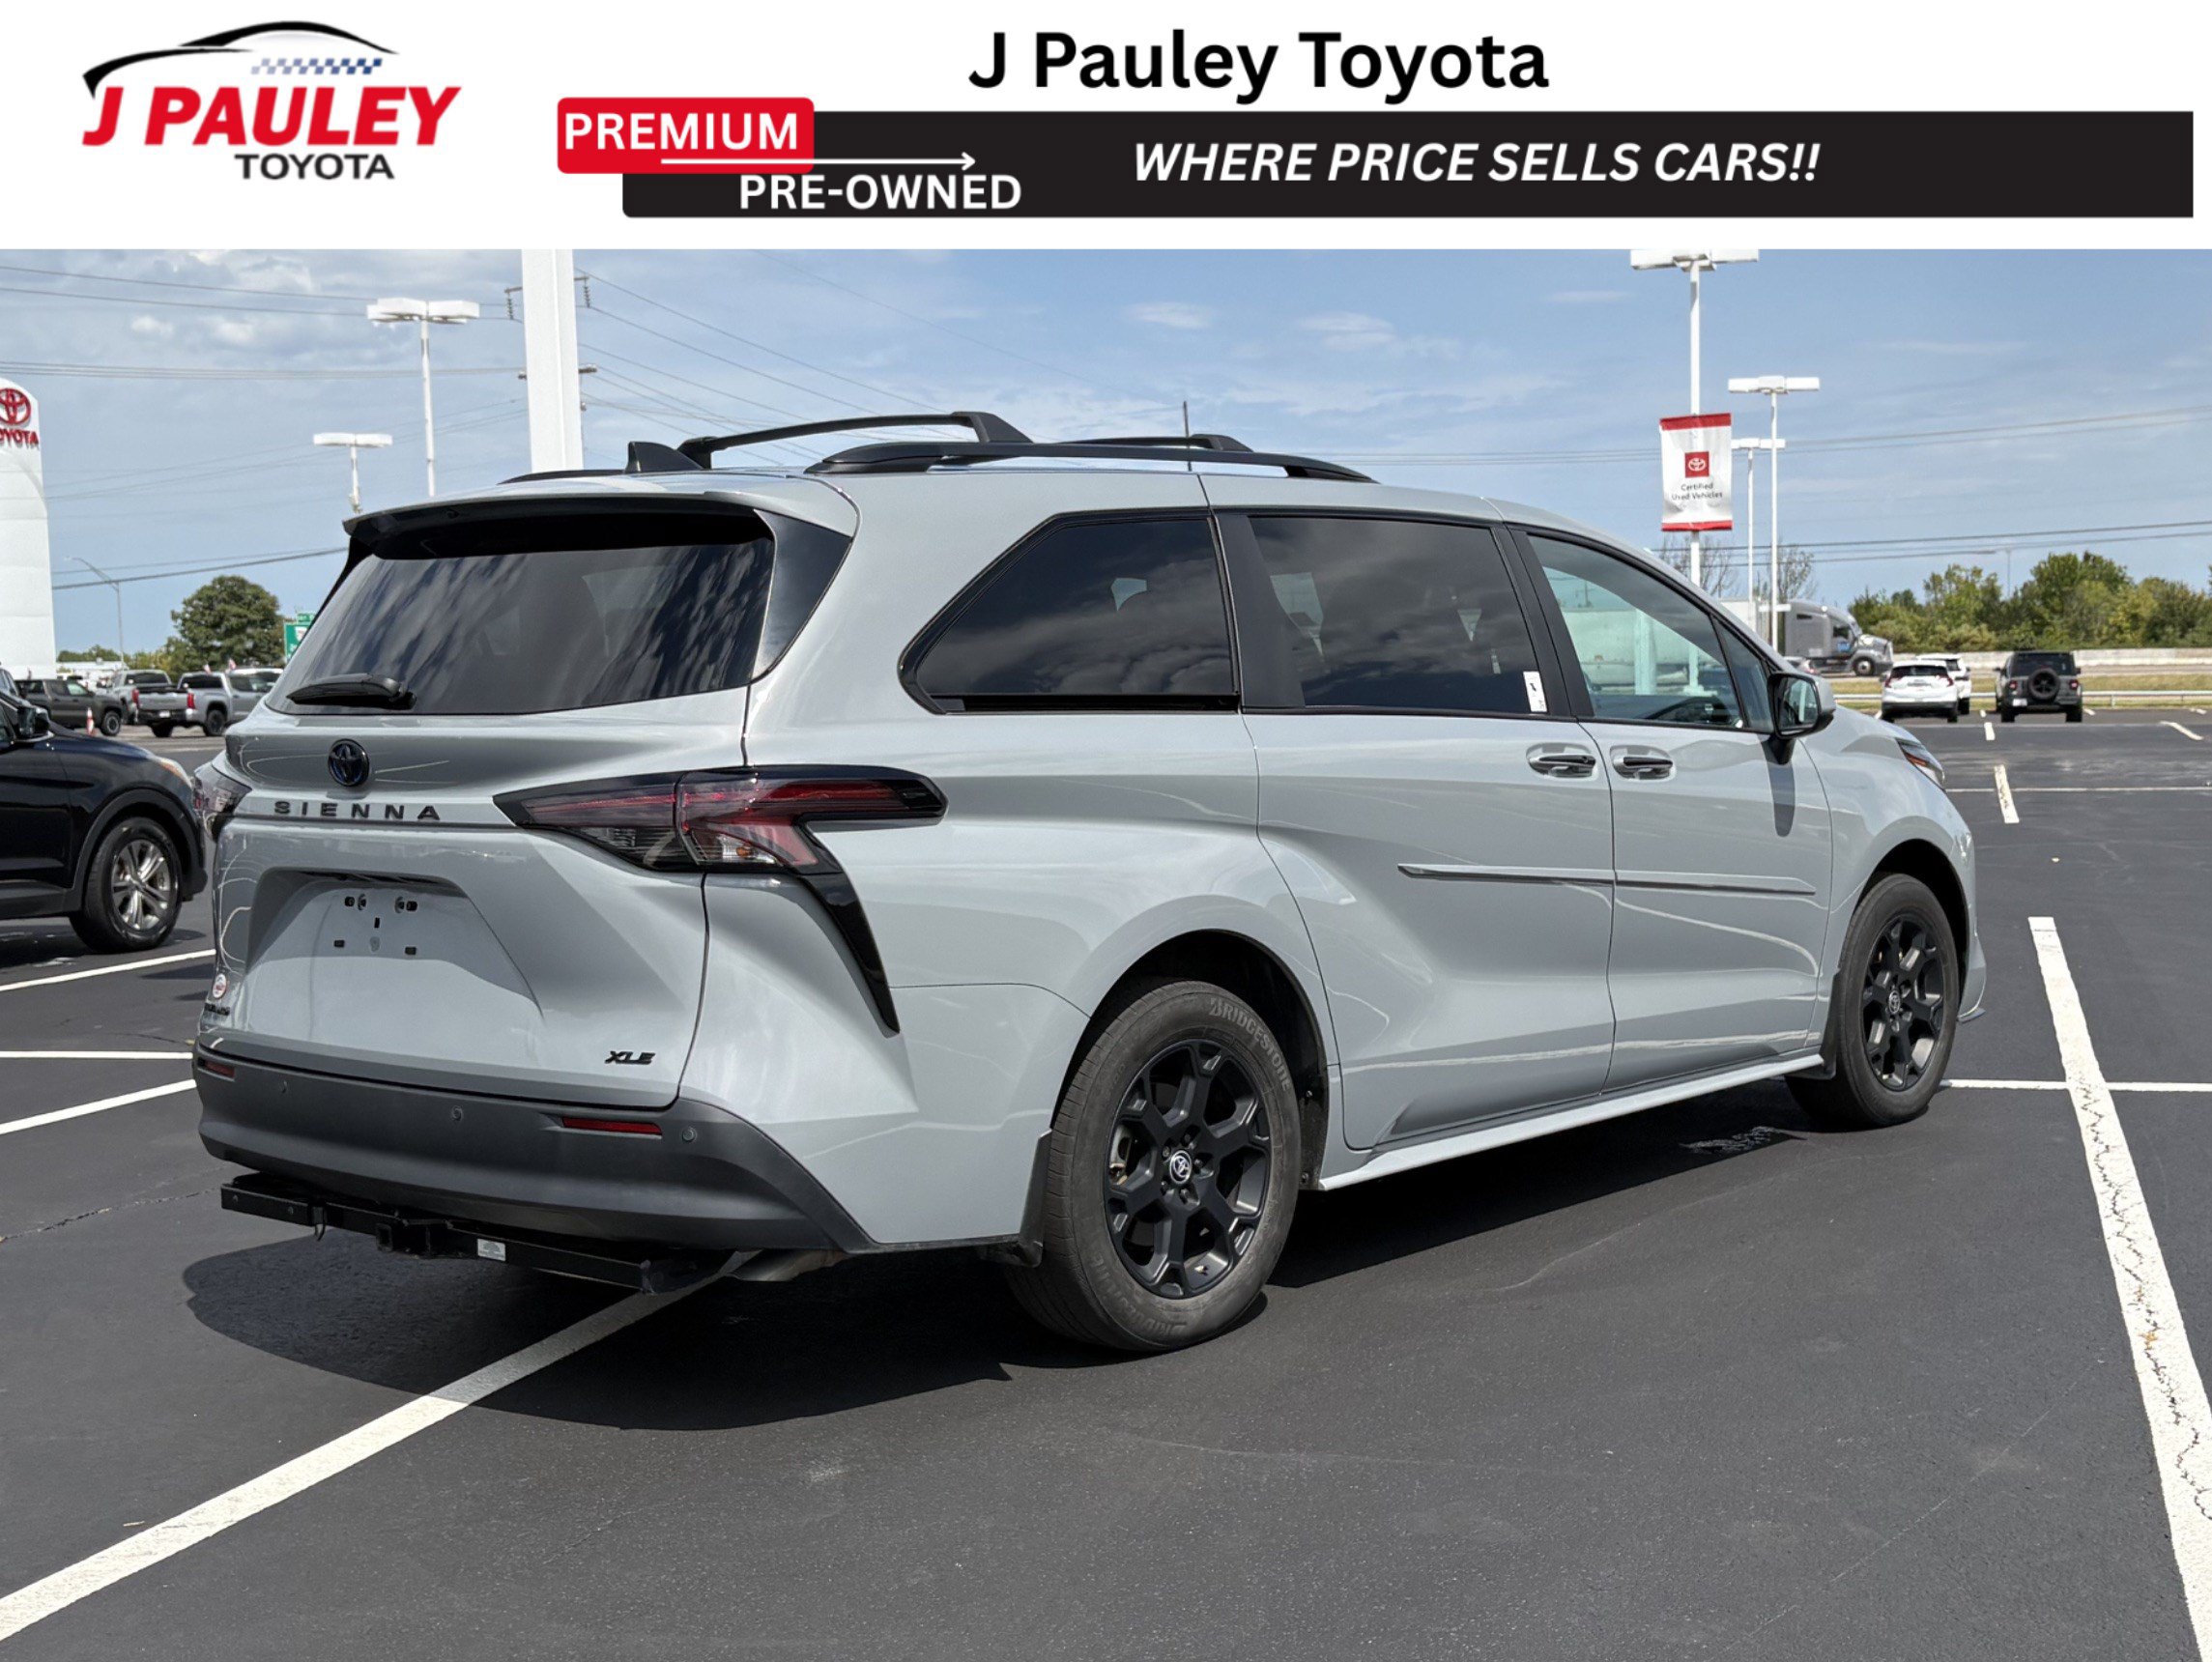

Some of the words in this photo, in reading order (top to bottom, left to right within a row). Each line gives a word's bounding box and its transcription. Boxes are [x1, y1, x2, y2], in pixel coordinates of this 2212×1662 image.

[1693, 491, 1723, 500] Vehicles
[274, 801, 441, 821] SIENNA
[1209, 997, 1292, 1092] BRIDGESTONE
[605, 1050, 656, 1065] XLE
